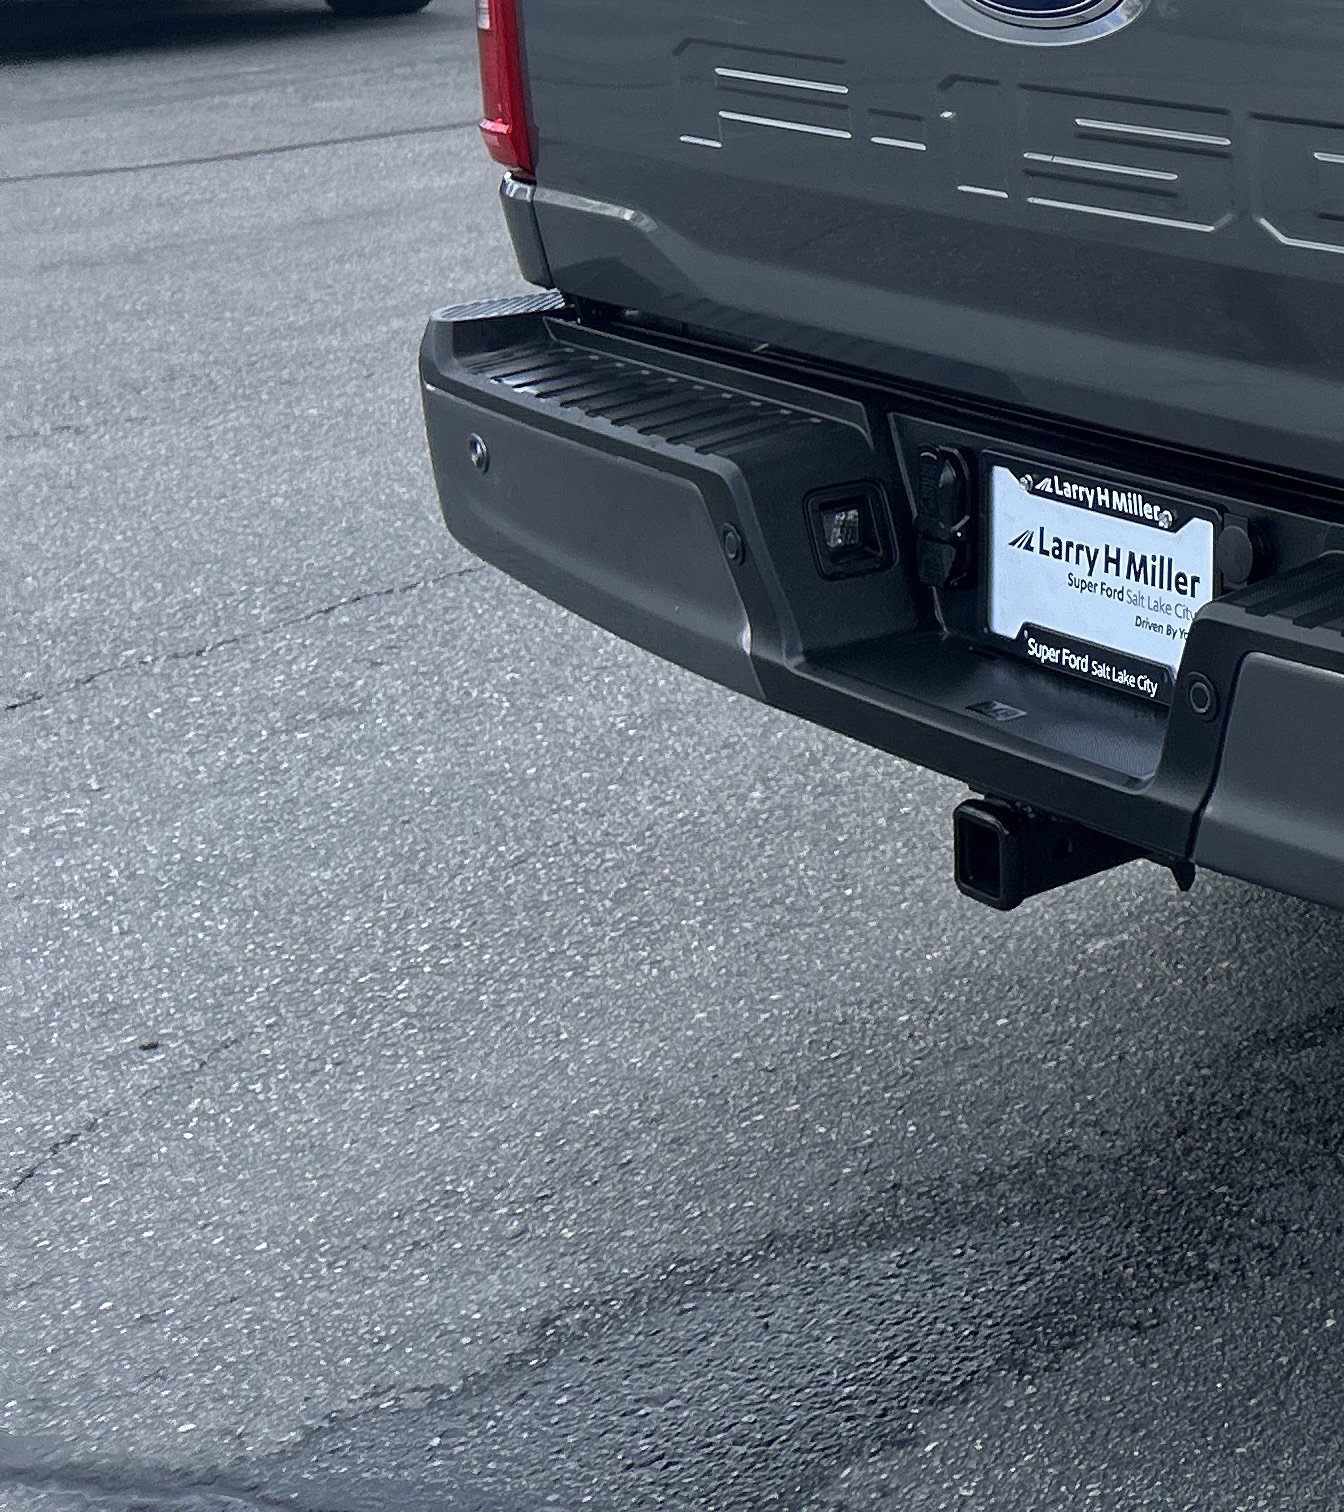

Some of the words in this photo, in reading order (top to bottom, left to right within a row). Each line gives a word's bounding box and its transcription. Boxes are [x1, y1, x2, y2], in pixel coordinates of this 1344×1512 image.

[1053, 475, 1094, 507] Larry
[1098, 486, 1111, 509] H
[1112, 490, 1161, 522] Miller
[1038, 526, 1099, 577] Larry
[1103, 544, 1121, 577] H
[1125, 550, 1201, 599] Miller
[1067, 572, 1099, 594] Super
[1100, 582, 1124, 602] Ford
[1126, 588, 1146, 609] Salt
[1148, 597, 1173, 616] Lake
[1135, 615, 1164, 635] Driven
[1166, 623, 1178, 640] By
[1027, 638, 1061, 664] Super
[1061, 649, 1089, 673] Ford
[1091, 660, 1111, 681] Salt
[1112, 666, 1136, 689] Lake
[1136, 675, 1158, 698] City
